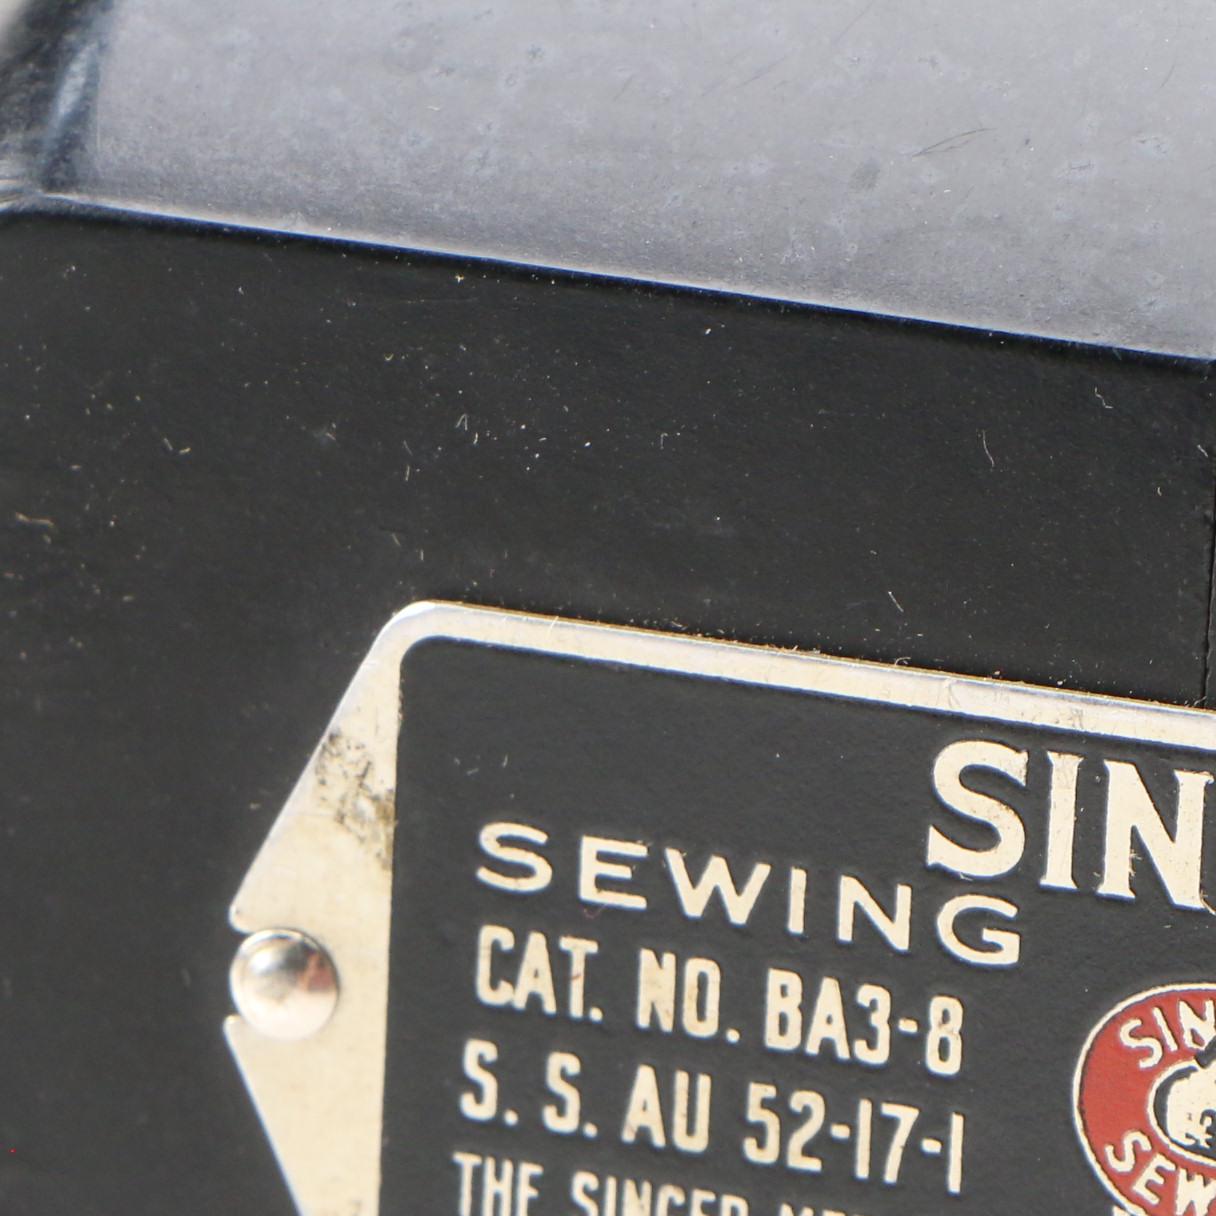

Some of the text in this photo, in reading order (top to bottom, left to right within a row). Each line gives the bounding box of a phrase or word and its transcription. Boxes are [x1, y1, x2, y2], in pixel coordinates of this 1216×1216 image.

[476, 823, 1019, 965] SEWING
[476, 926, 962, 1075] CAT. NO. BA3-8
[621, 1065, 711, 1152] AU
[743, 1082, 963, 1193] 52-17-1
